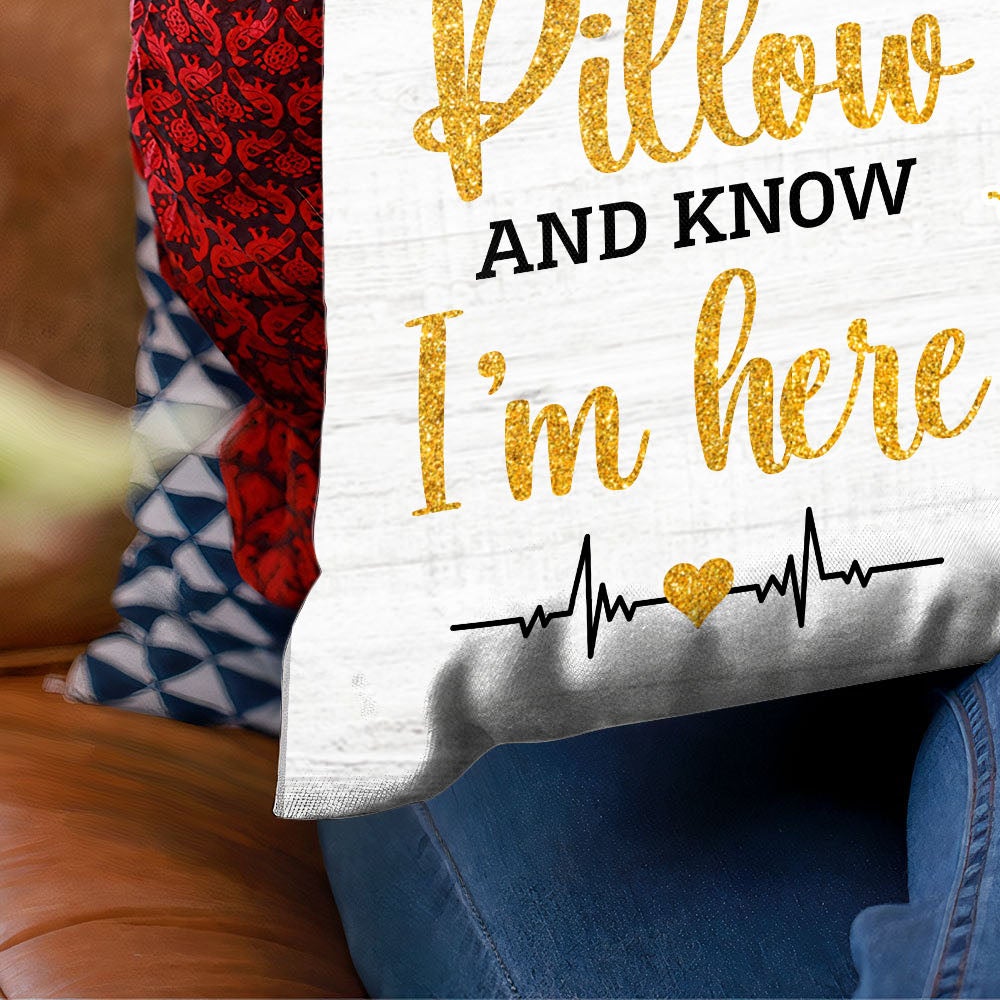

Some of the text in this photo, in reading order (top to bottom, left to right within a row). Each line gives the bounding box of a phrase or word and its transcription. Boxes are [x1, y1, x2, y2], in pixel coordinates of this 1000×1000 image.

[475, 157, 917, 281] AND KNOW
[404, 267, 992, 517] I'm here
